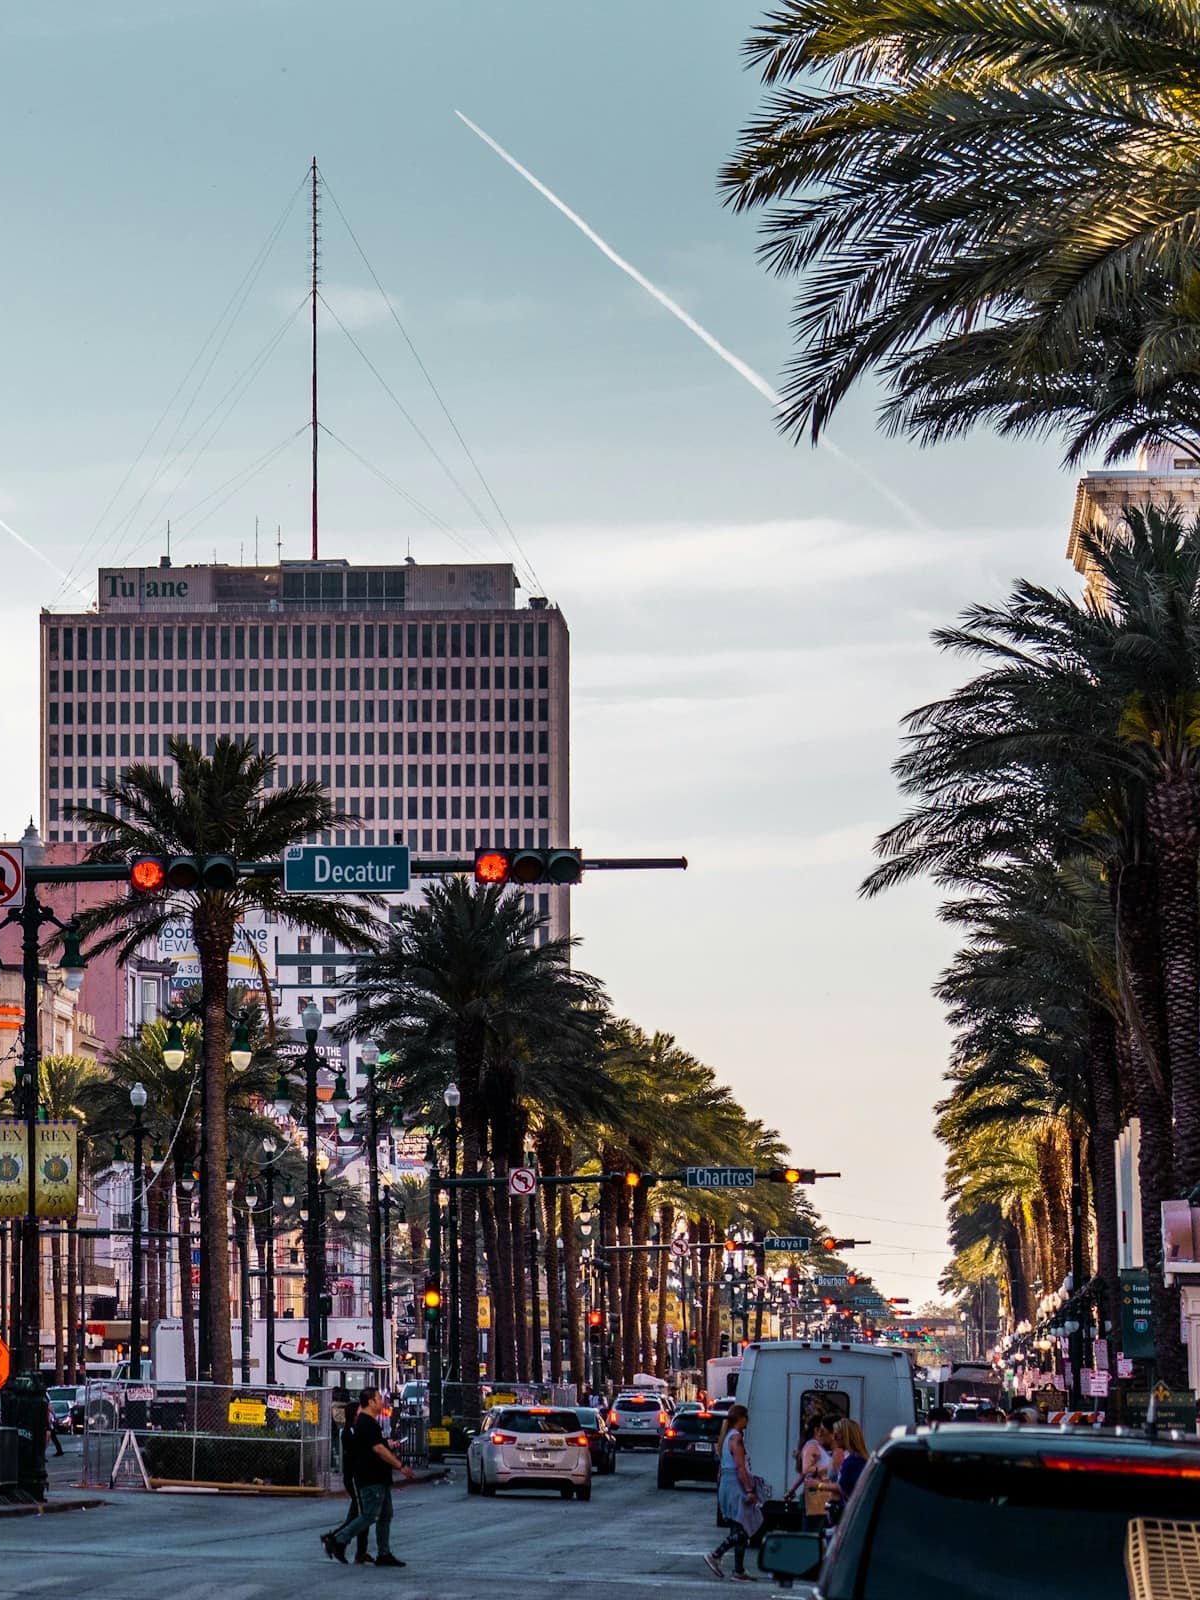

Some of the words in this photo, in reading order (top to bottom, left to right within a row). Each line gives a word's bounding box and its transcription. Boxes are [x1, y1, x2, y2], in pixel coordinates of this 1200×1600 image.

[104, 575, 189, 598] Tuane
[314, 855, 396, 883] Decatur
[160, 928, 193, 939] OOD
[314, 1046, 325, 1056] TO
[326, 1046, 342, 1057] THE
[41, 1130, 71, 1141] REX
[696, 1167, 753, 1186] Chartres
[773, 1238, 803, 1250] Royal
[818, 1276, 847, 1287] Bourbon
[297, 1338, 366, 1354] Rder
[814, 1379, 839, 1390] SS-127
